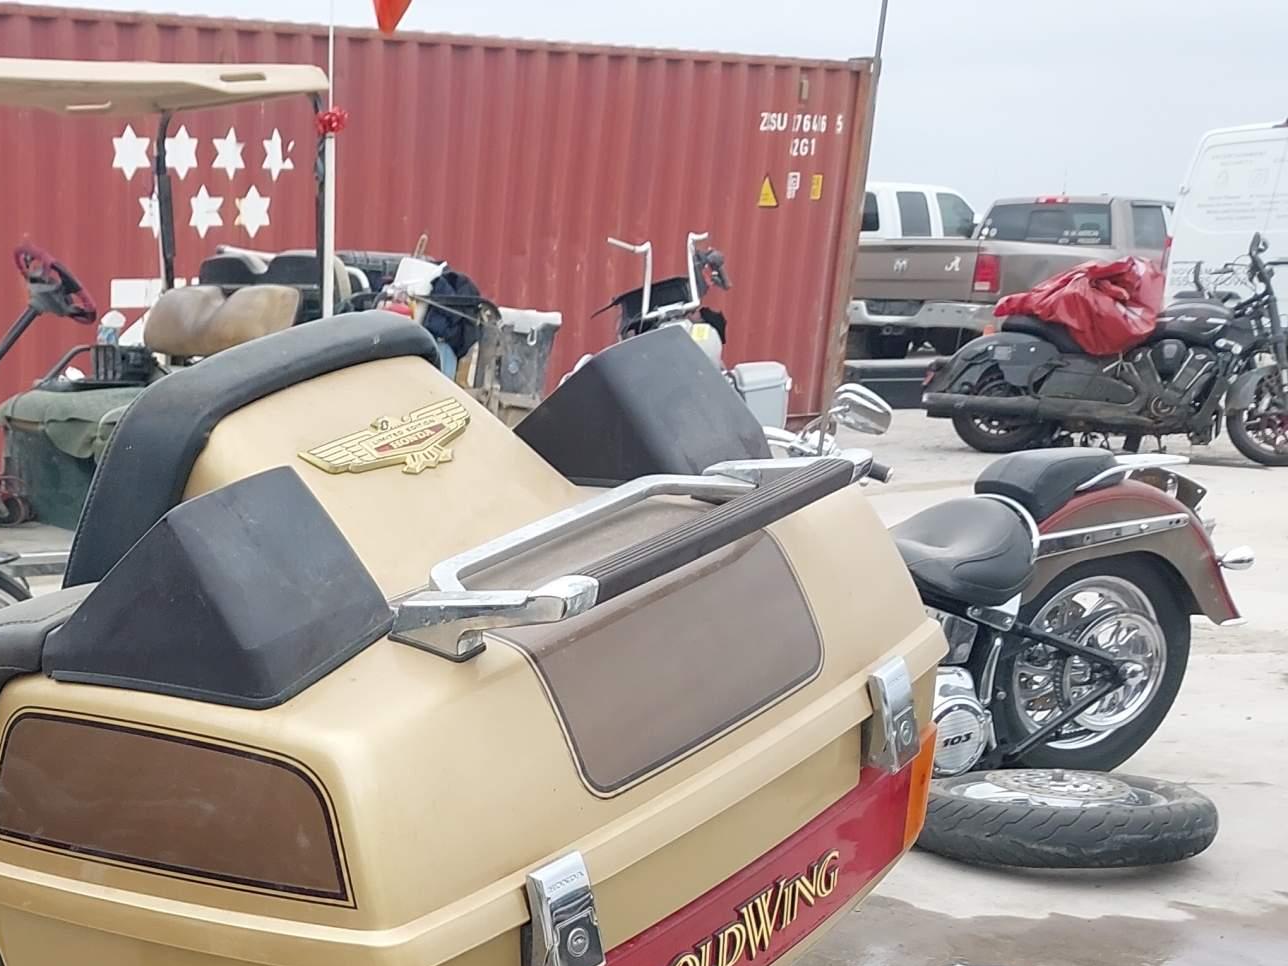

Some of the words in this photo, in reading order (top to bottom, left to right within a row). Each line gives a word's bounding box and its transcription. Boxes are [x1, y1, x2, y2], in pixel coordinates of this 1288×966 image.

[790, 138, 816, 156] 2G1
[372, 429, 403, 446] LIMITED
[405, 418, 436, 433] EDITION
[390, 428, 436, 449] HONDA
[943, 732, 974, 748] 103
